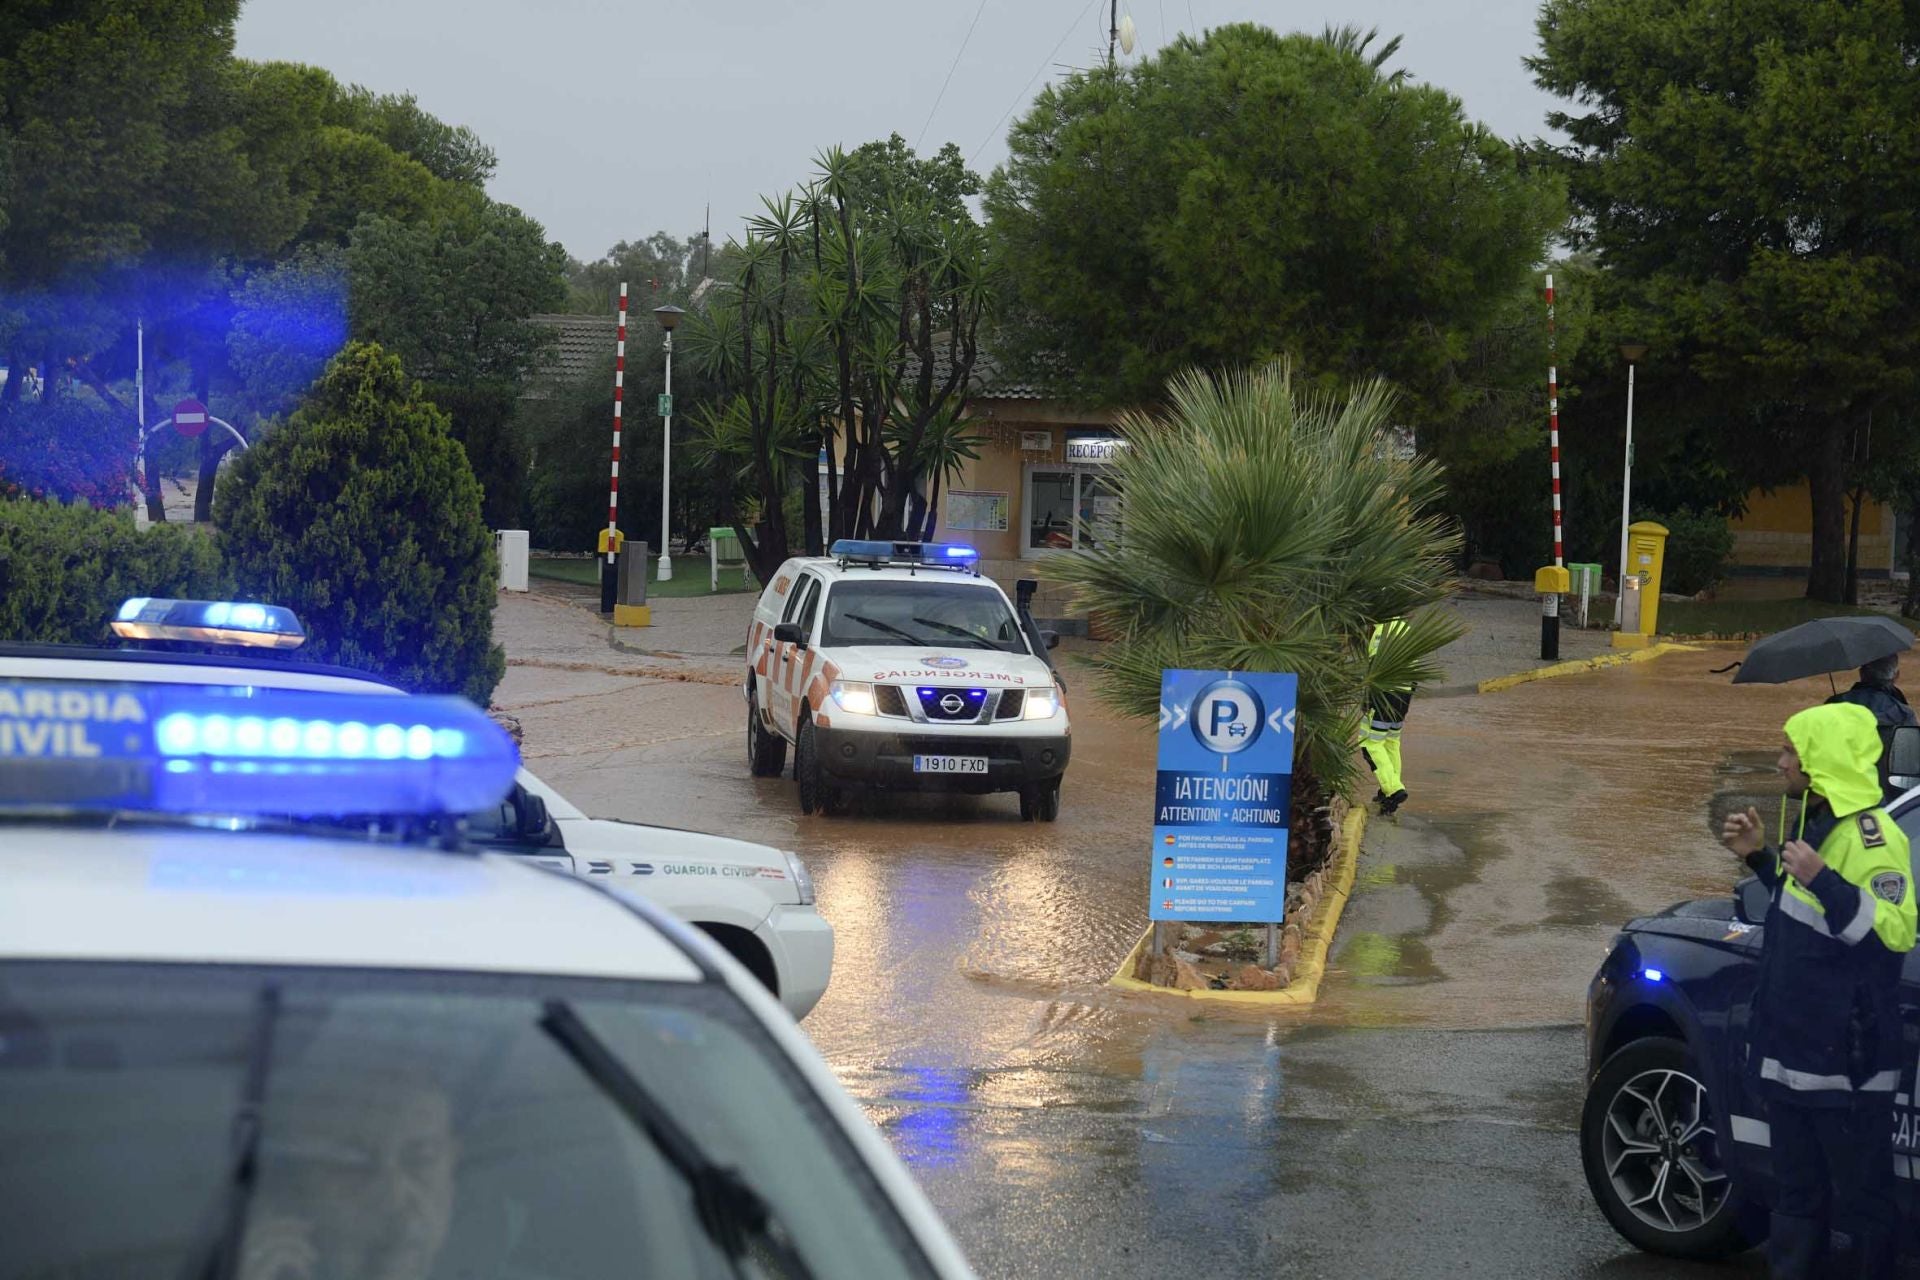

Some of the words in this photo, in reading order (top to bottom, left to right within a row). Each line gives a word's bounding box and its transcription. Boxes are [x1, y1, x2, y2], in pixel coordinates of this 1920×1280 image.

[1068, 443, 1132, 459] RECEPCI
[1210, 699, 1239, 736] P
[925, 758, 956, 770] 1910
[961, 759, 985, 771] FXD
[1175, 774, 1269, 801] ¡ATENCIÓN!
[1160, 806, 1221, 821] ATTENTION!
[1231, 808, 1281, 824] ACHTUNG
[663, 864, 718, 876] GUARDIA
